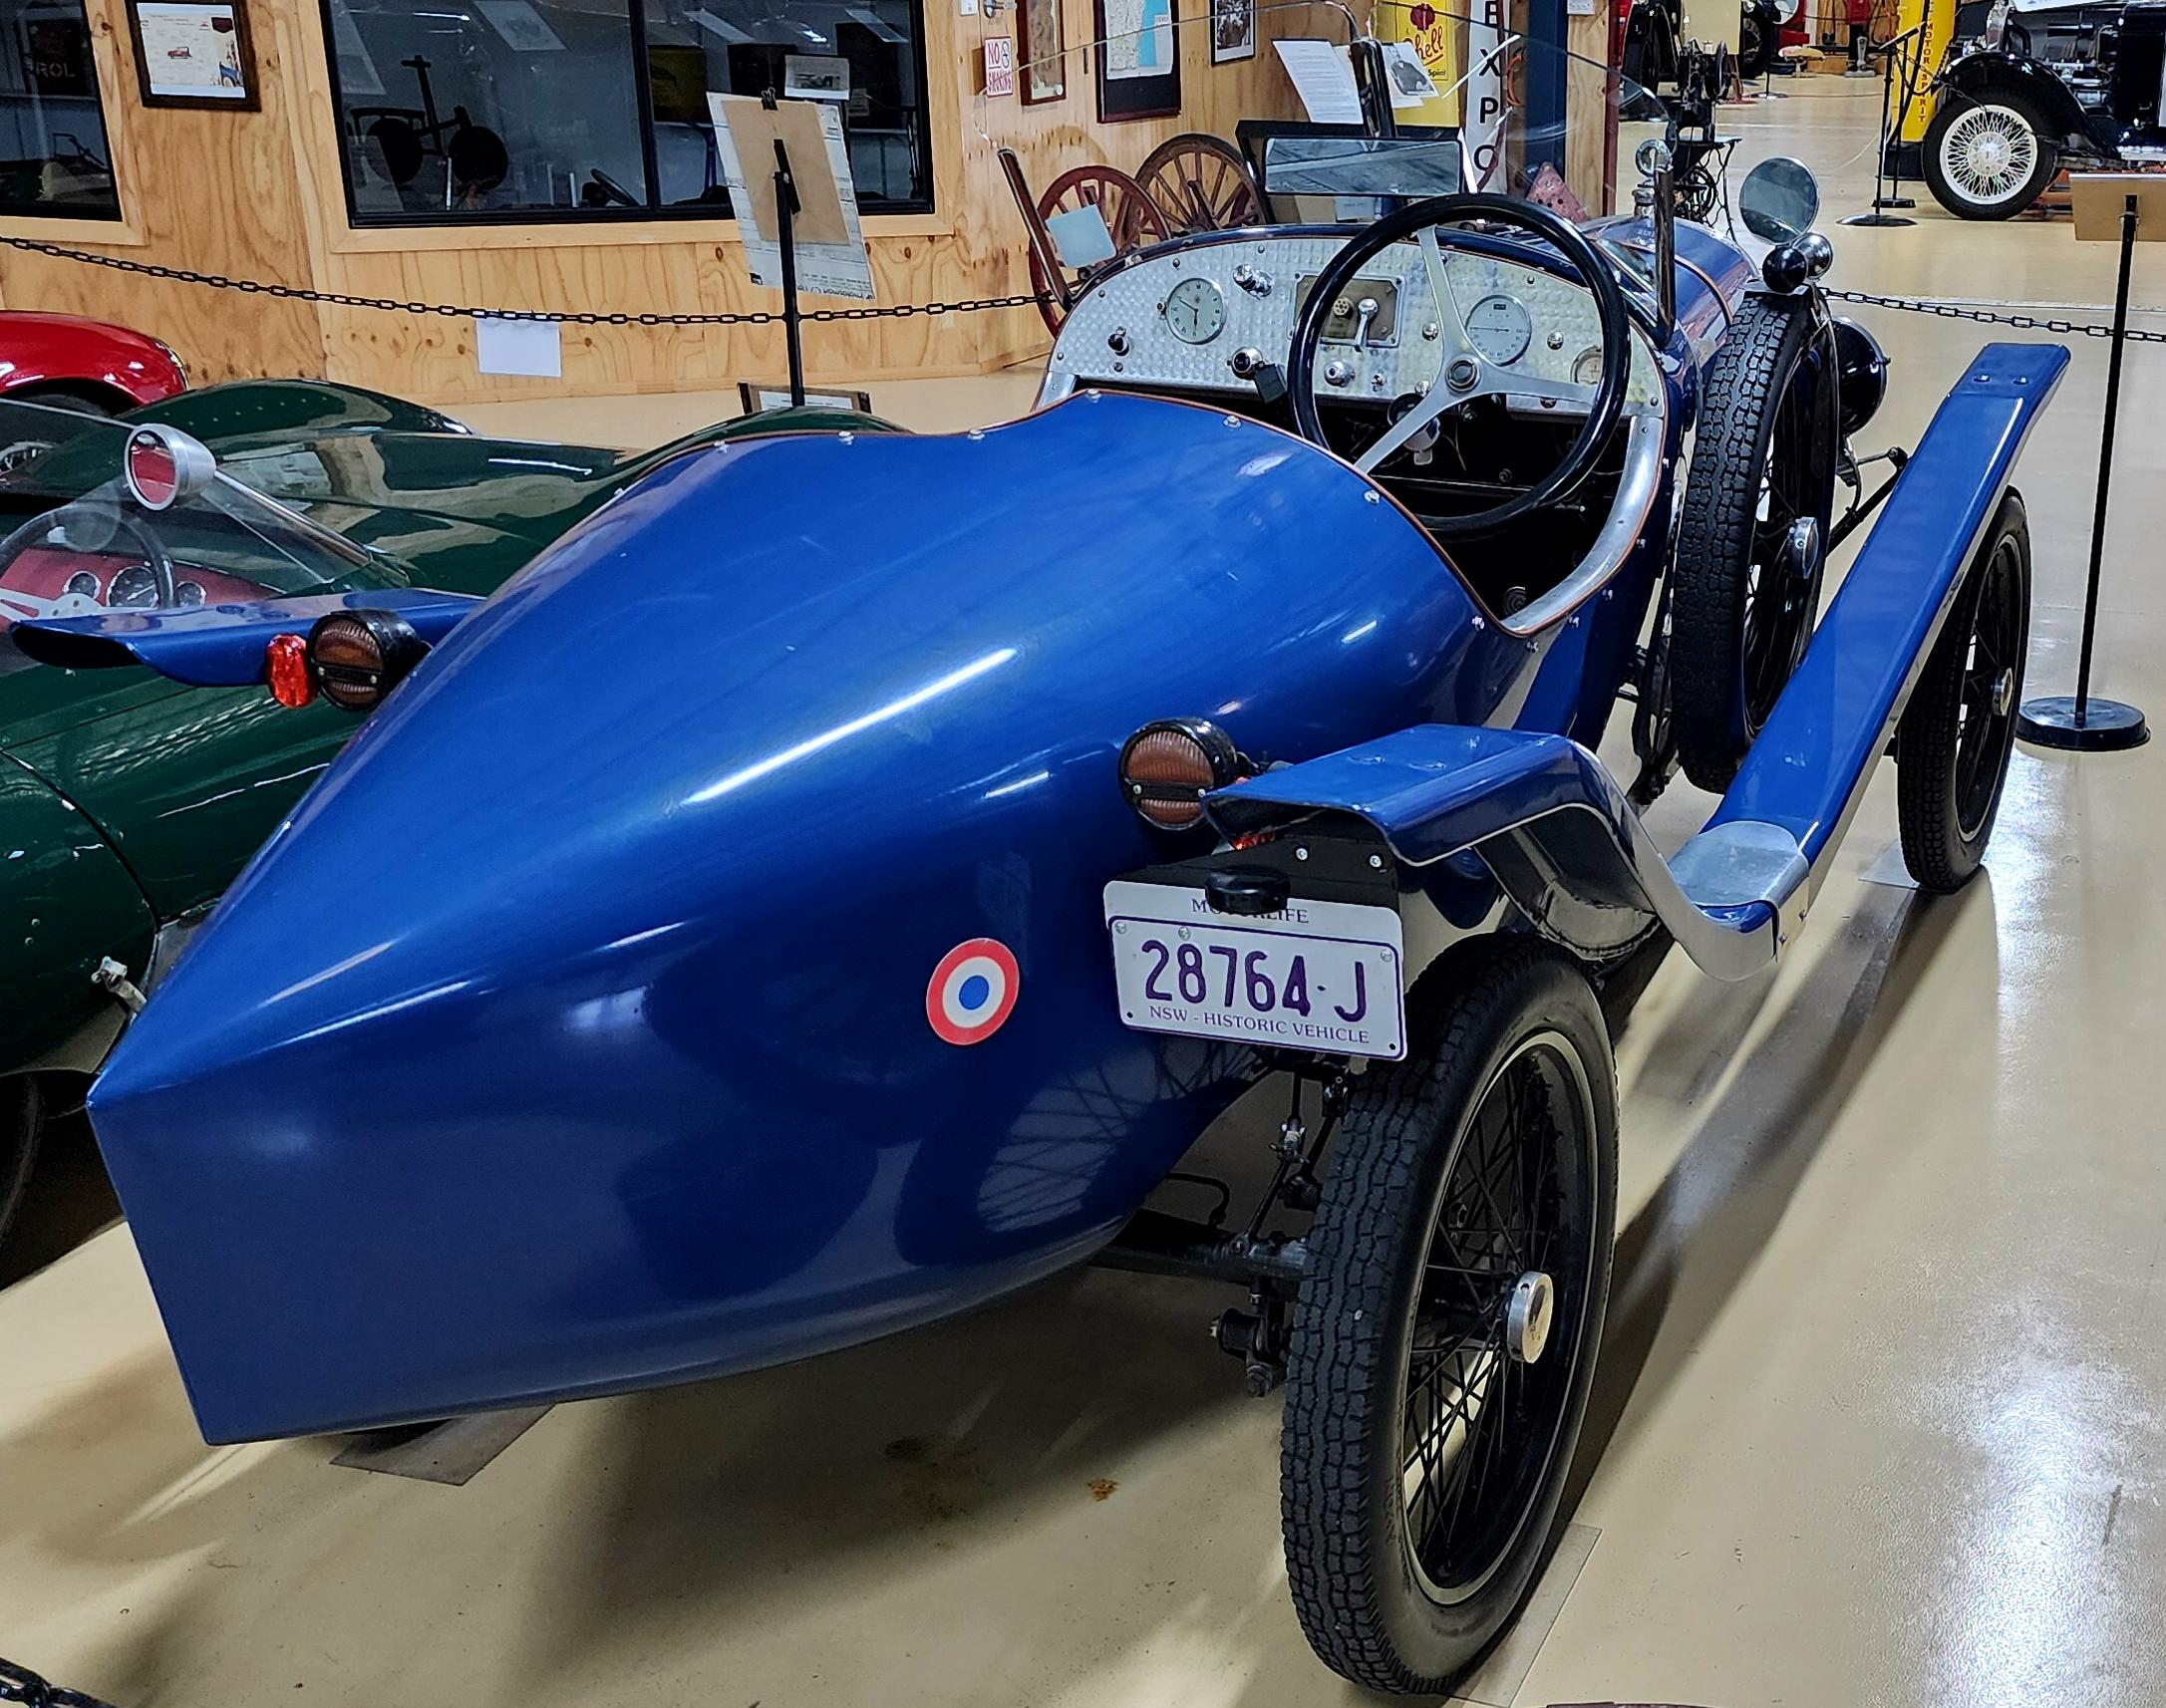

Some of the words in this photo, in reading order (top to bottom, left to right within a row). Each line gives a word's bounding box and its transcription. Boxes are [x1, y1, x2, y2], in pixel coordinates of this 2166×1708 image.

[988, 43, 1000, 65] NO
[1402, 26, 1444, 60] hell
[1923, 23, 1933, 64] MOTOR
[1919, 74, 1929, 123] SPRIT
[1149, 1005, 1188, 1021] NSW
[1203, 1012, 1288, 1034] HISTORIC
[1293, 1022, 1370, 1044] VEHICLE
